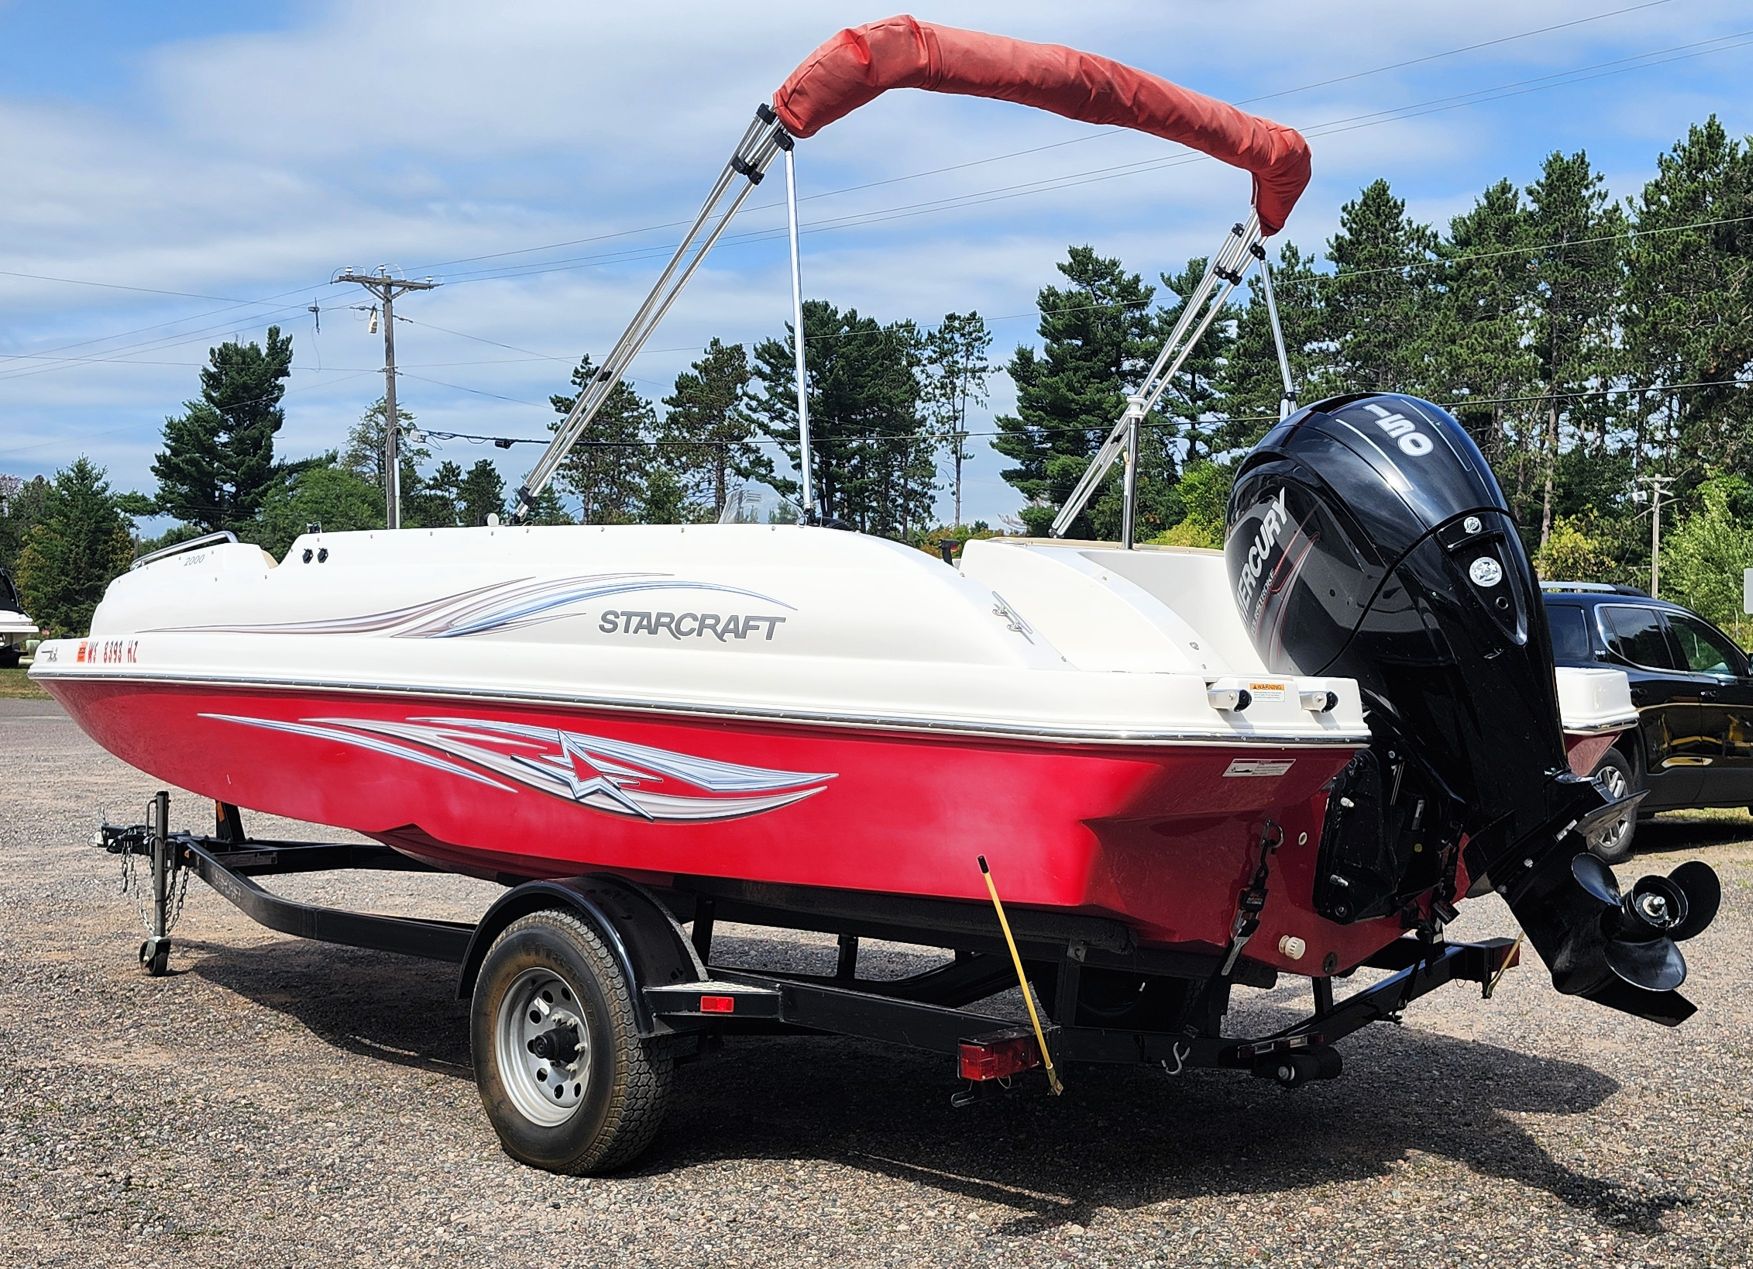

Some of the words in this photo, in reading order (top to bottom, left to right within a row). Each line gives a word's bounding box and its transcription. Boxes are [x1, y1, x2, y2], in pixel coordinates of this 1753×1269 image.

[1363, 403, 1434, 457] 150
[599, 609, 786, 643] STARCRAFT
[127, 640, 139, 664] HZ
[1258, 683, 1283, 691] WARNING
